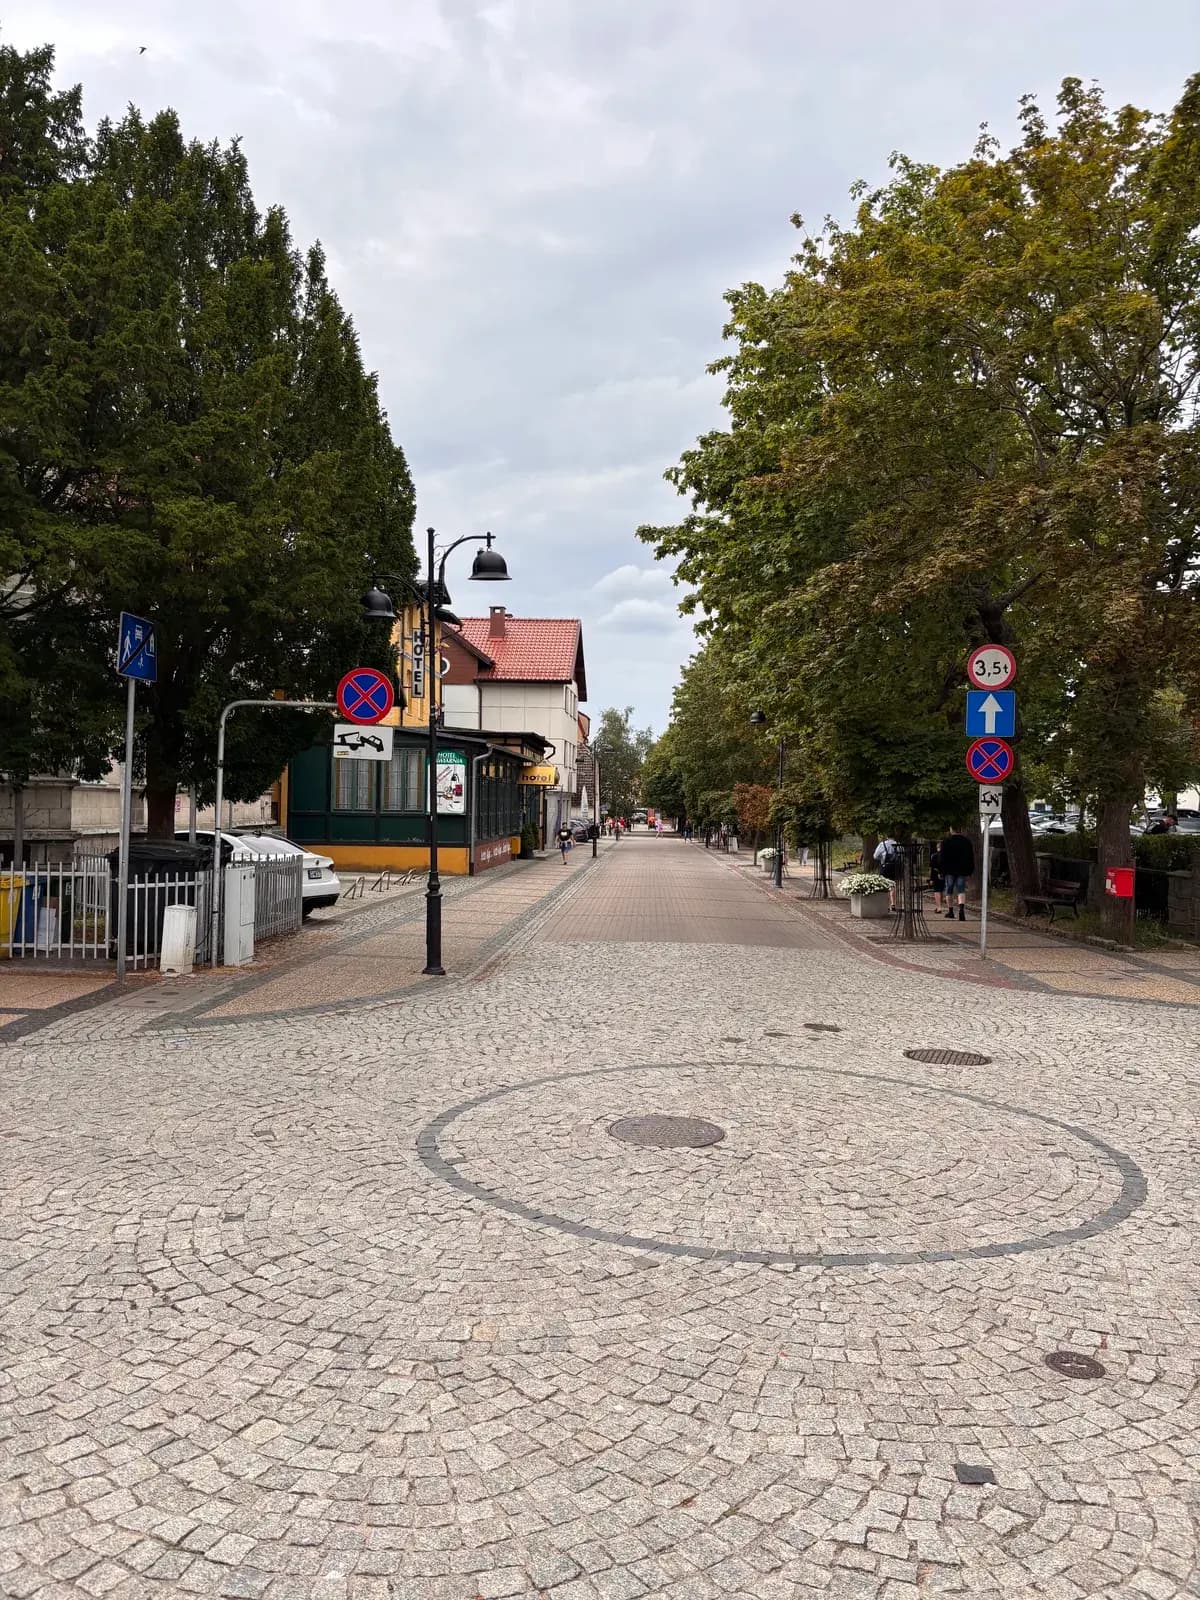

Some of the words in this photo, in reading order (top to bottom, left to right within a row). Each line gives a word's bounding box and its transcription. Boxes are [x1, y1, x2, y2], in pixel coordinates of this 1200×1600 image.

[413, 630, 423, 695] HOTEL
[975, 660, 1009, 677] 3,5t
[521, 774, 552, 782] hotel
